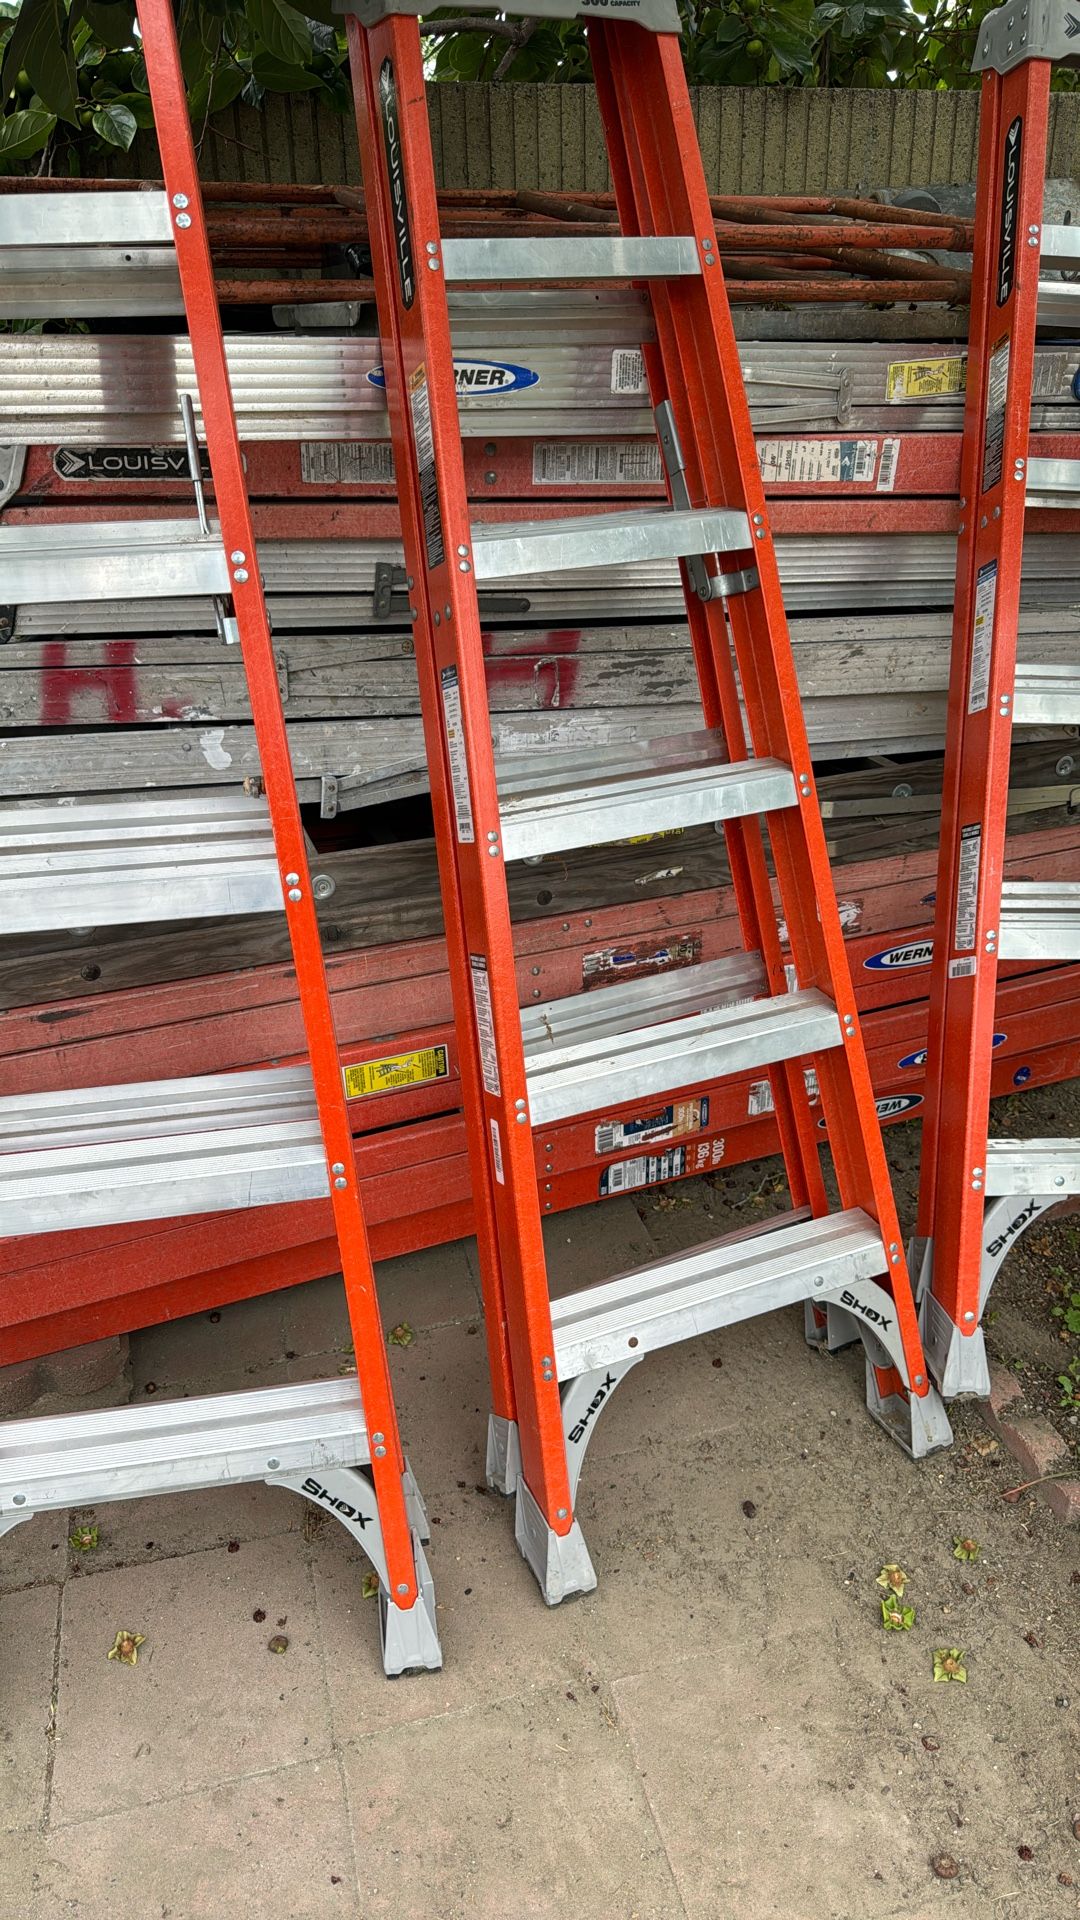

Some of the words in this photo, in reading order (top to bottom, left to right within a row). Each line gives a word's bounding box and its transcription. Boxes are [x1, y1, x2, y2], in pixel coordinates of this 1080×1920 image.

[385, 97, 412, 302] LOUISVILLE
[1000, 145, 1017, 302] LOUISVILLE
[88, 456, 209, 471] LOUISV
[40, 641, 137, 725] H
[889, 945, 933, 963] WERN
[438, 1049, 446, 1075] CAUTION
[876, 1099, 902, 1112] WE
[697, 1143, 710, 1158] 136
[986, 1197, 1042, 1257] SHOX
[840, 1290, 893, 1332] SHOX
[568, 1372, 617, 1444] SHOX
[301, 1477, 374, 1530] SHOX
